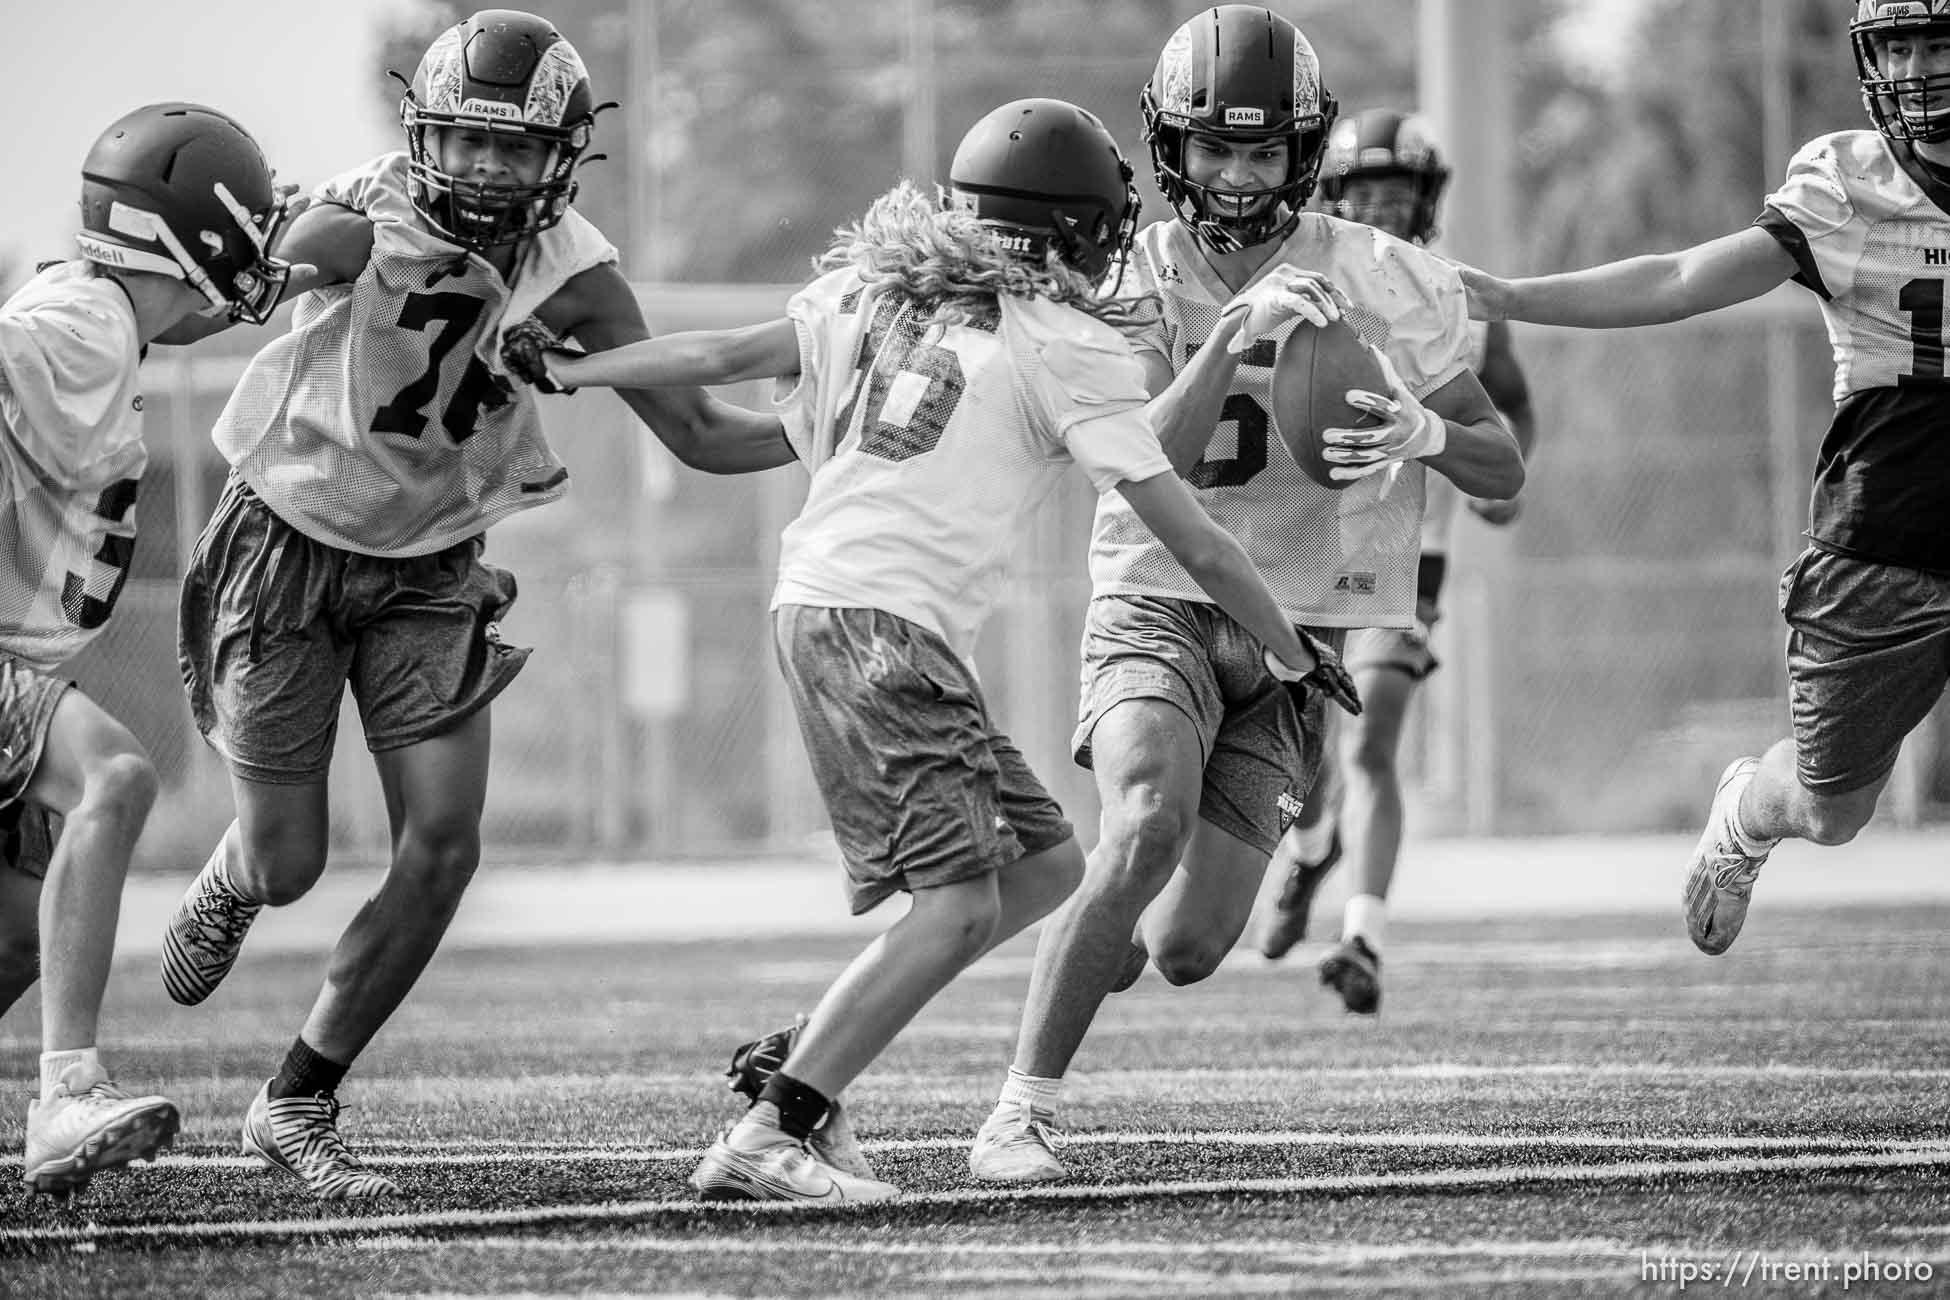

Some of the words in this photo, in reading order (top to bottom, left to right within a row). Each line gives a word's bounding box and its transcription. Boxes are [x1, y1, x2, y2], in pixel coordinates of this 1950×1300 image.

[1887, 5, 1910, 16] RAMS
[474, 103, 507, 117] RAMS
[1229, 111, 1261, 121] RAMS
[1924, 248, 1950, 265] HI
